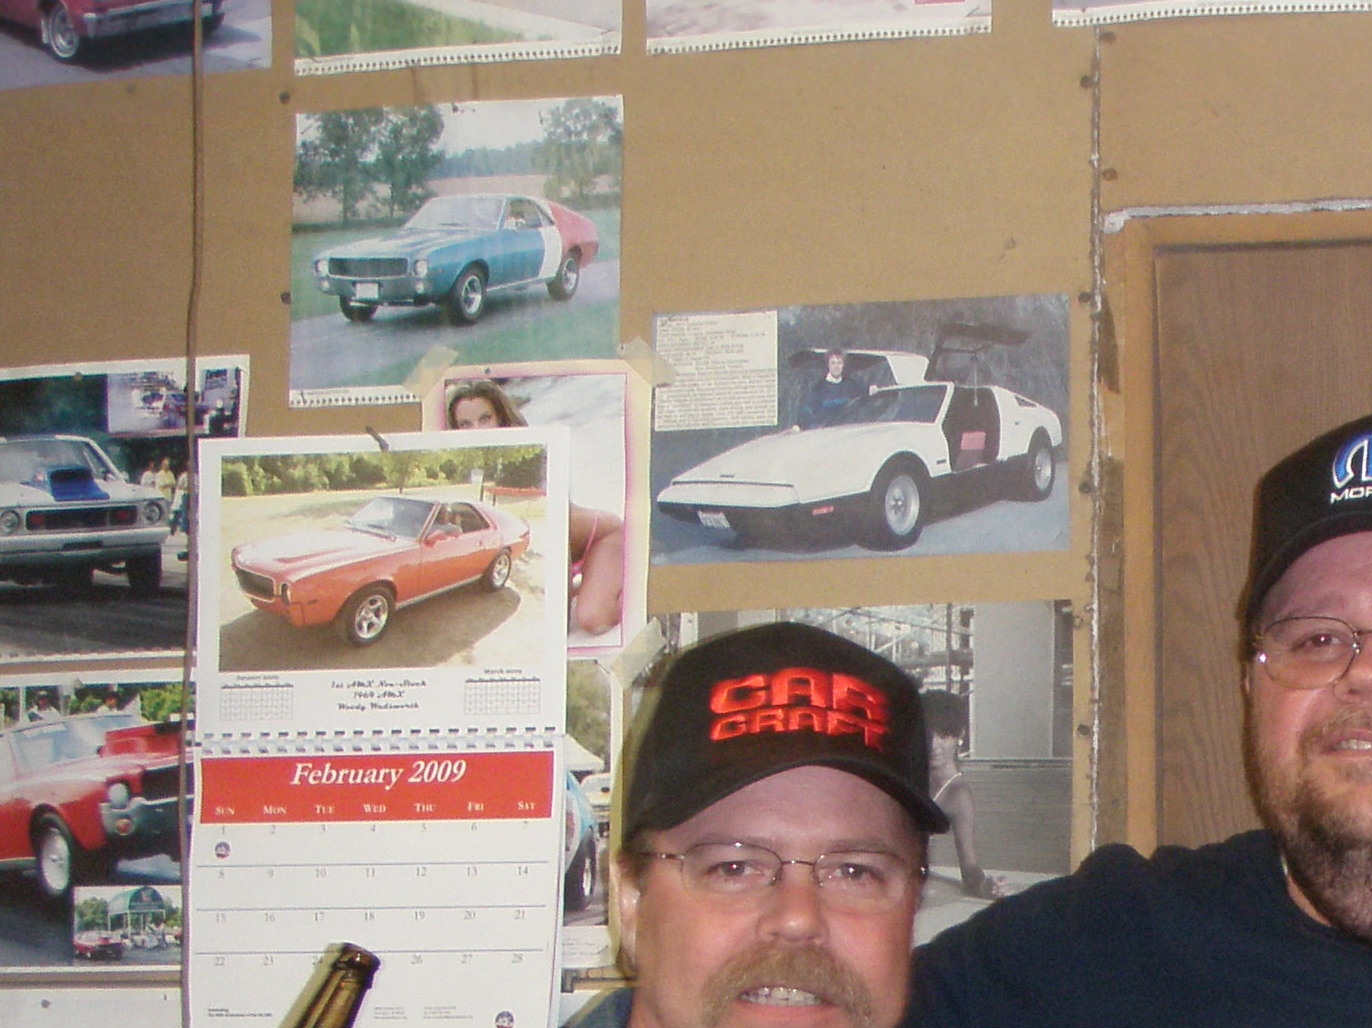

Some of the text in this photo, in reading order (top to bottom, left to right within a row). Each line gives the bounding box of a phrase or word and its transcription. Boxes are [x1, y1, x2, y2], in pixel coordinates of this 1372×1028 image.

[710, 667, 889, 722] CAR
[710, 707, 888, 752] CRAFT
[290, 759, 467, 791] February 2009
[263, 805, 287, 815] MON
[315, 804, 335, 814] TUE
[363, 803, 387, 814] WED
[415, 802, 436, 812] THU
[468, 801, 485, 811] FRI
[518, 800, 536, 810] SAT
